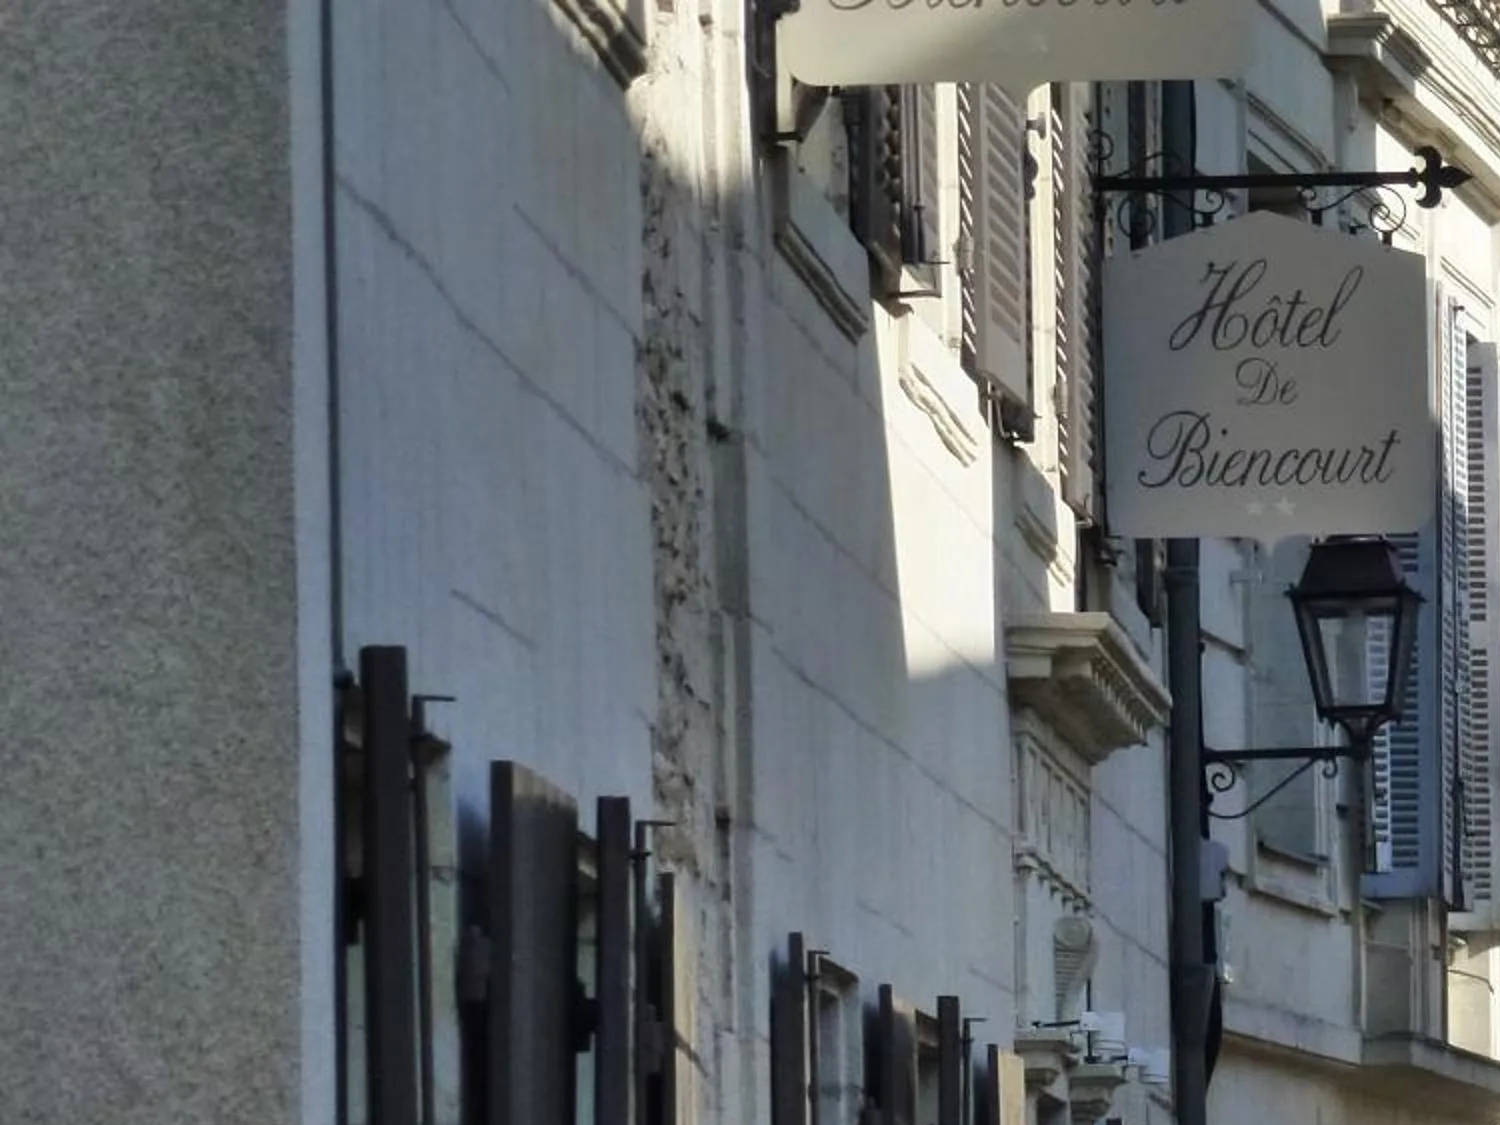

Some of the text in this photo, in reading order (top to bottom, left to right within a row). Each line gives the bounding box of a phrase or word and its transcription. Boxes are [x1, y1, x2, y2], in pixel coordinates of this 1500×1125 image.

[1169, 258, 1363, 351] Hôtel
[1235, 357, 1297, 406] De
[1138, 410, 1400, 487] Biencourt
